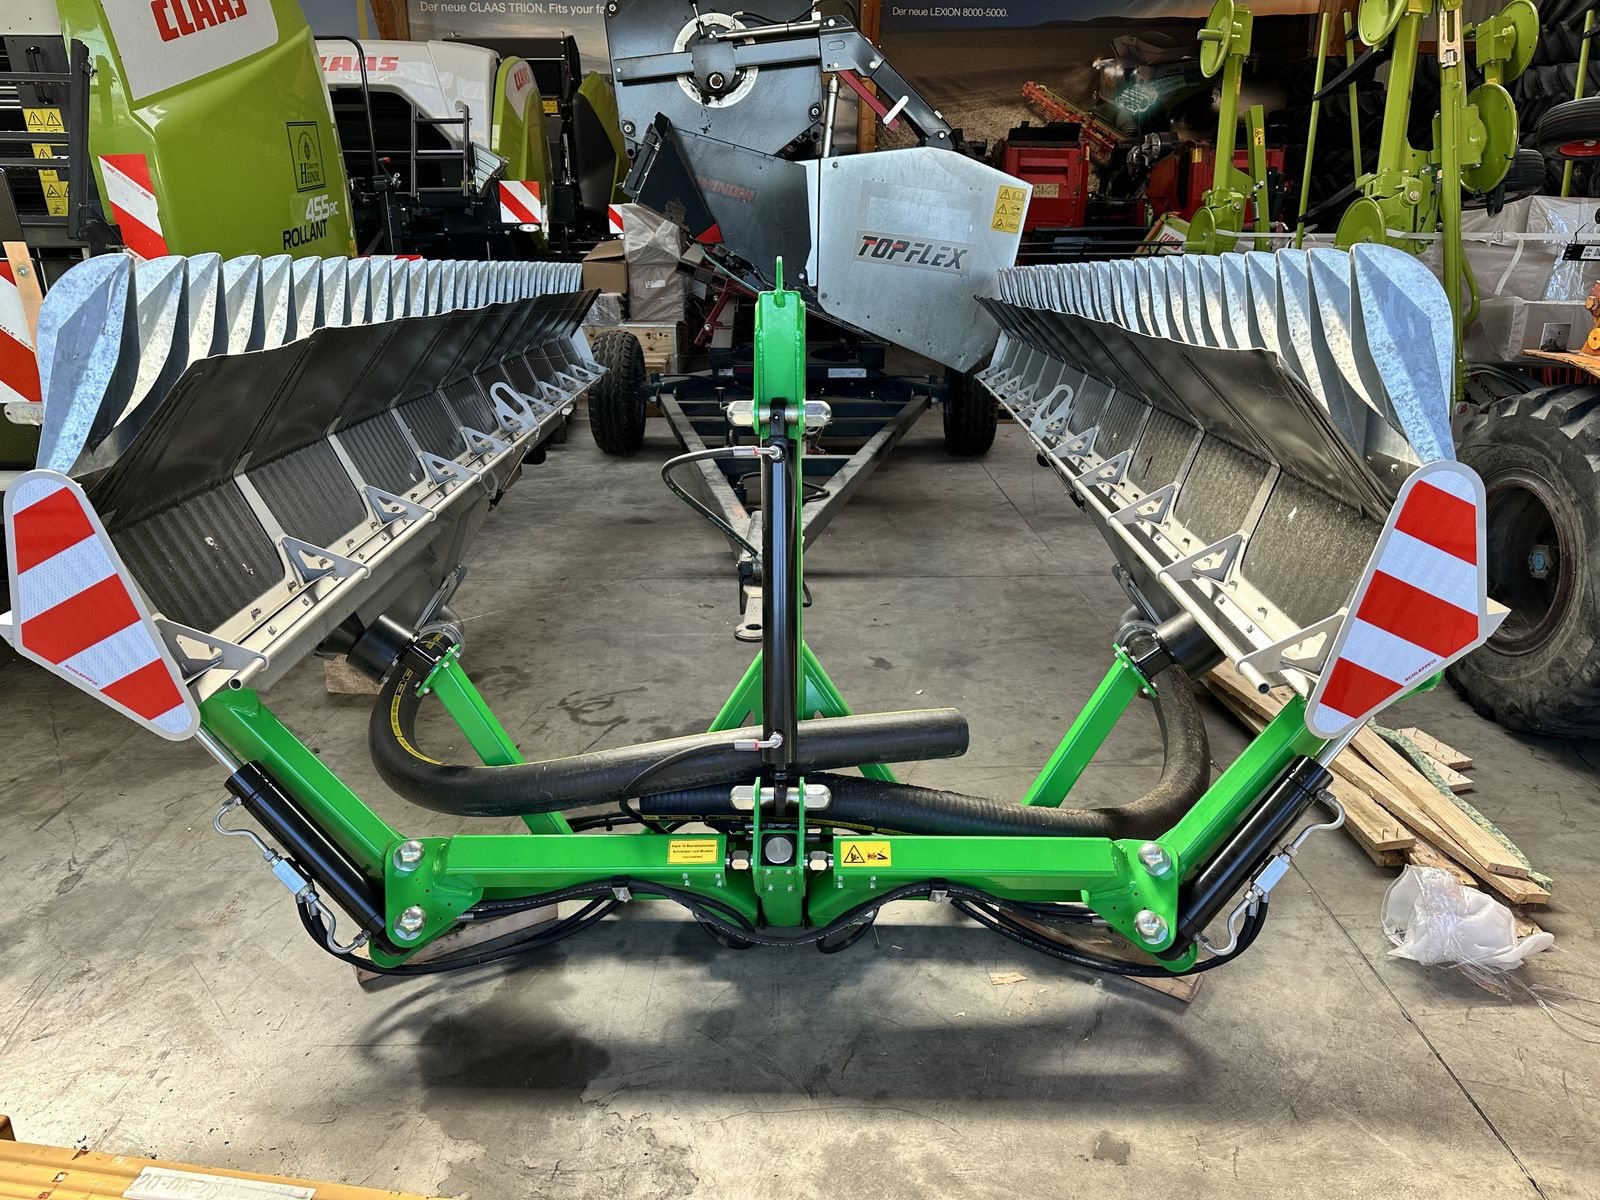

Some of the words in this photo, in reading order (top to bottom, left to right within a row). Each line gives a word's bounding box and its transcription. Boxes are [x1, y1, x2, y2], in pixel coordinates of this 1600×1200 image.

[420, 1, 439, 12] Der
[441, 3, 467, 12] neue
[469, 2, 506, 13] CLAAS
[508, 3, 546, 13] TRION.
[549, 3, 568, 14] Fits
[570, 5, 593, 16] your
[892, 6, 907, 16] Der
[908, 8, 928, 16] neue
[929, 7, 961, 17] LEXION
[962, 8, 1009, 17] 8000-5000.
[320, 56, 400, 72] LAAS
[283, 219, 328, 251] ROLLANT
[858, 235, 969, 270] TOPFLEX
